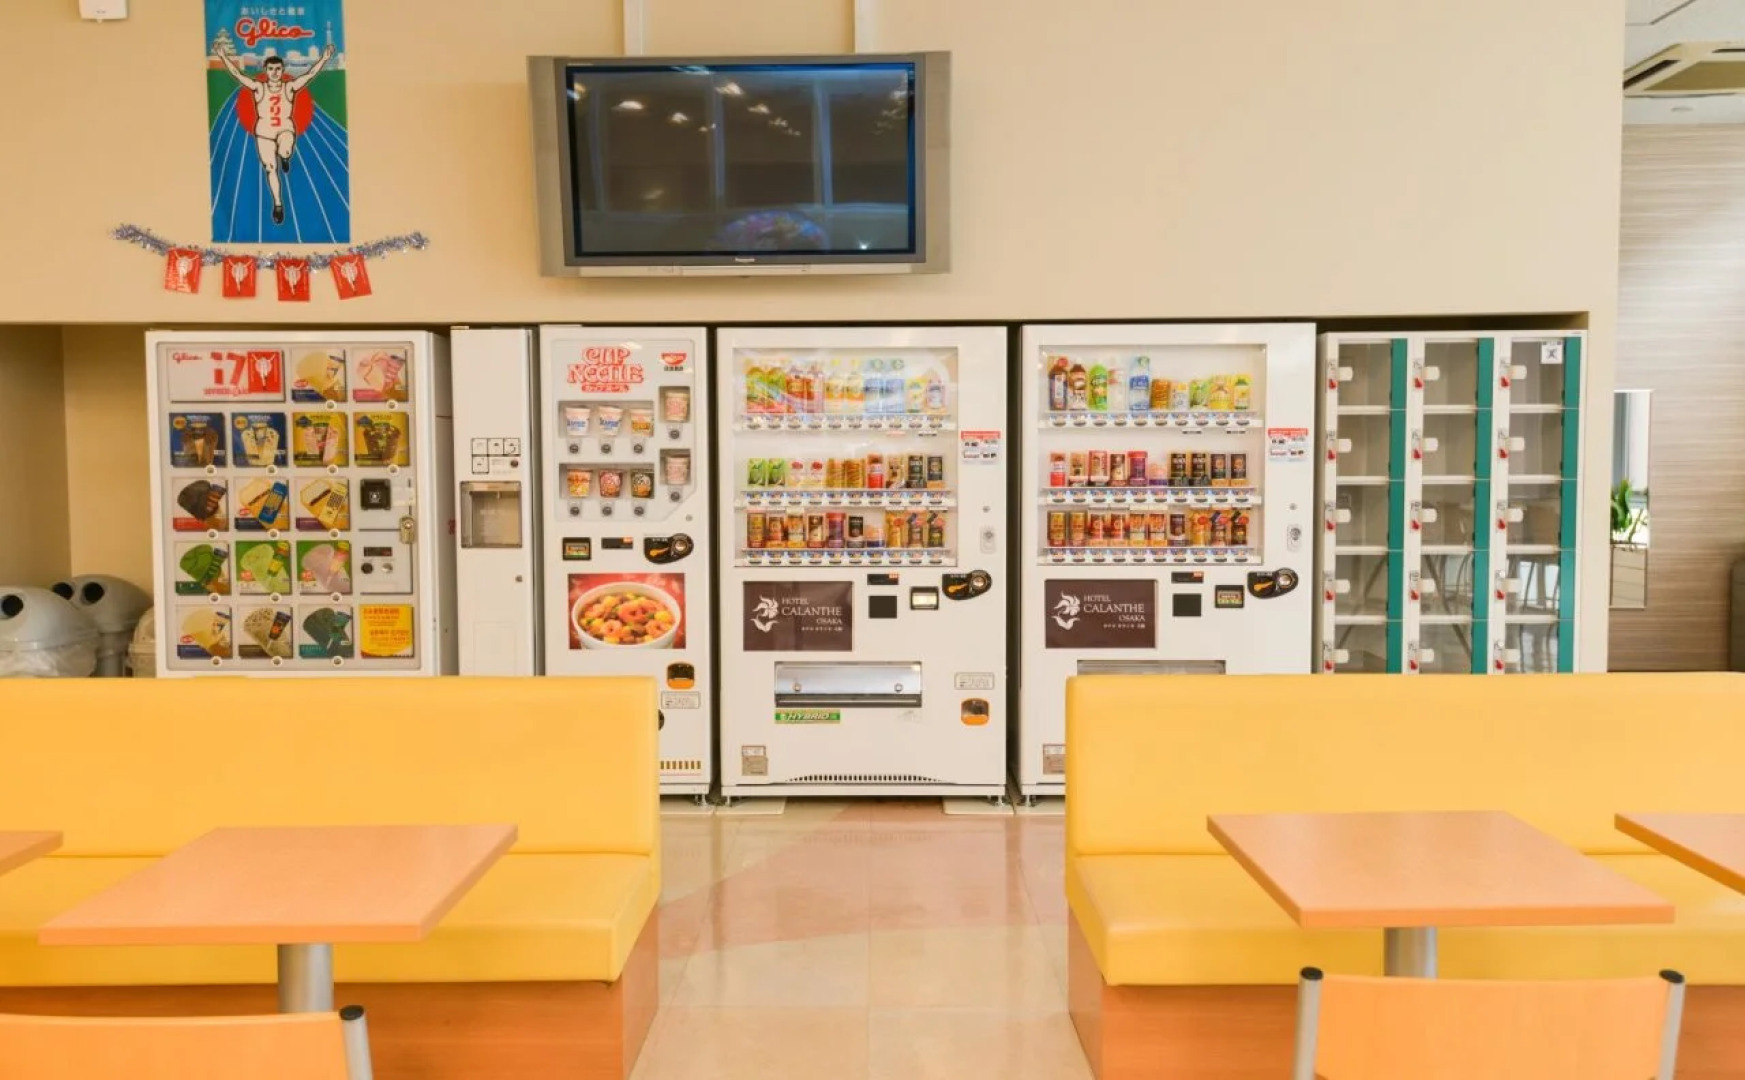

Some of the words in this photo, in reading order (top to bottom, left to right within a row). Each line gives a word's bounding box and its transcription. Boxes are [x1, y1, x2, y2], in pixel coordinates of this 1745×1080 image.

[235, 17, 314, 47] Glico
[268, 94, 282, 127] グリコ
[582, 348, 631, 366] CUP
[567, 363, 645, 384] NOODLE
[781, 606, 842, 616] CALANTHE
[1083, 603, 1145, 613] CALANTHE
[1118, 614, 1145, 622] OSAKA
[786, 712, 830, 721] HYBRID
